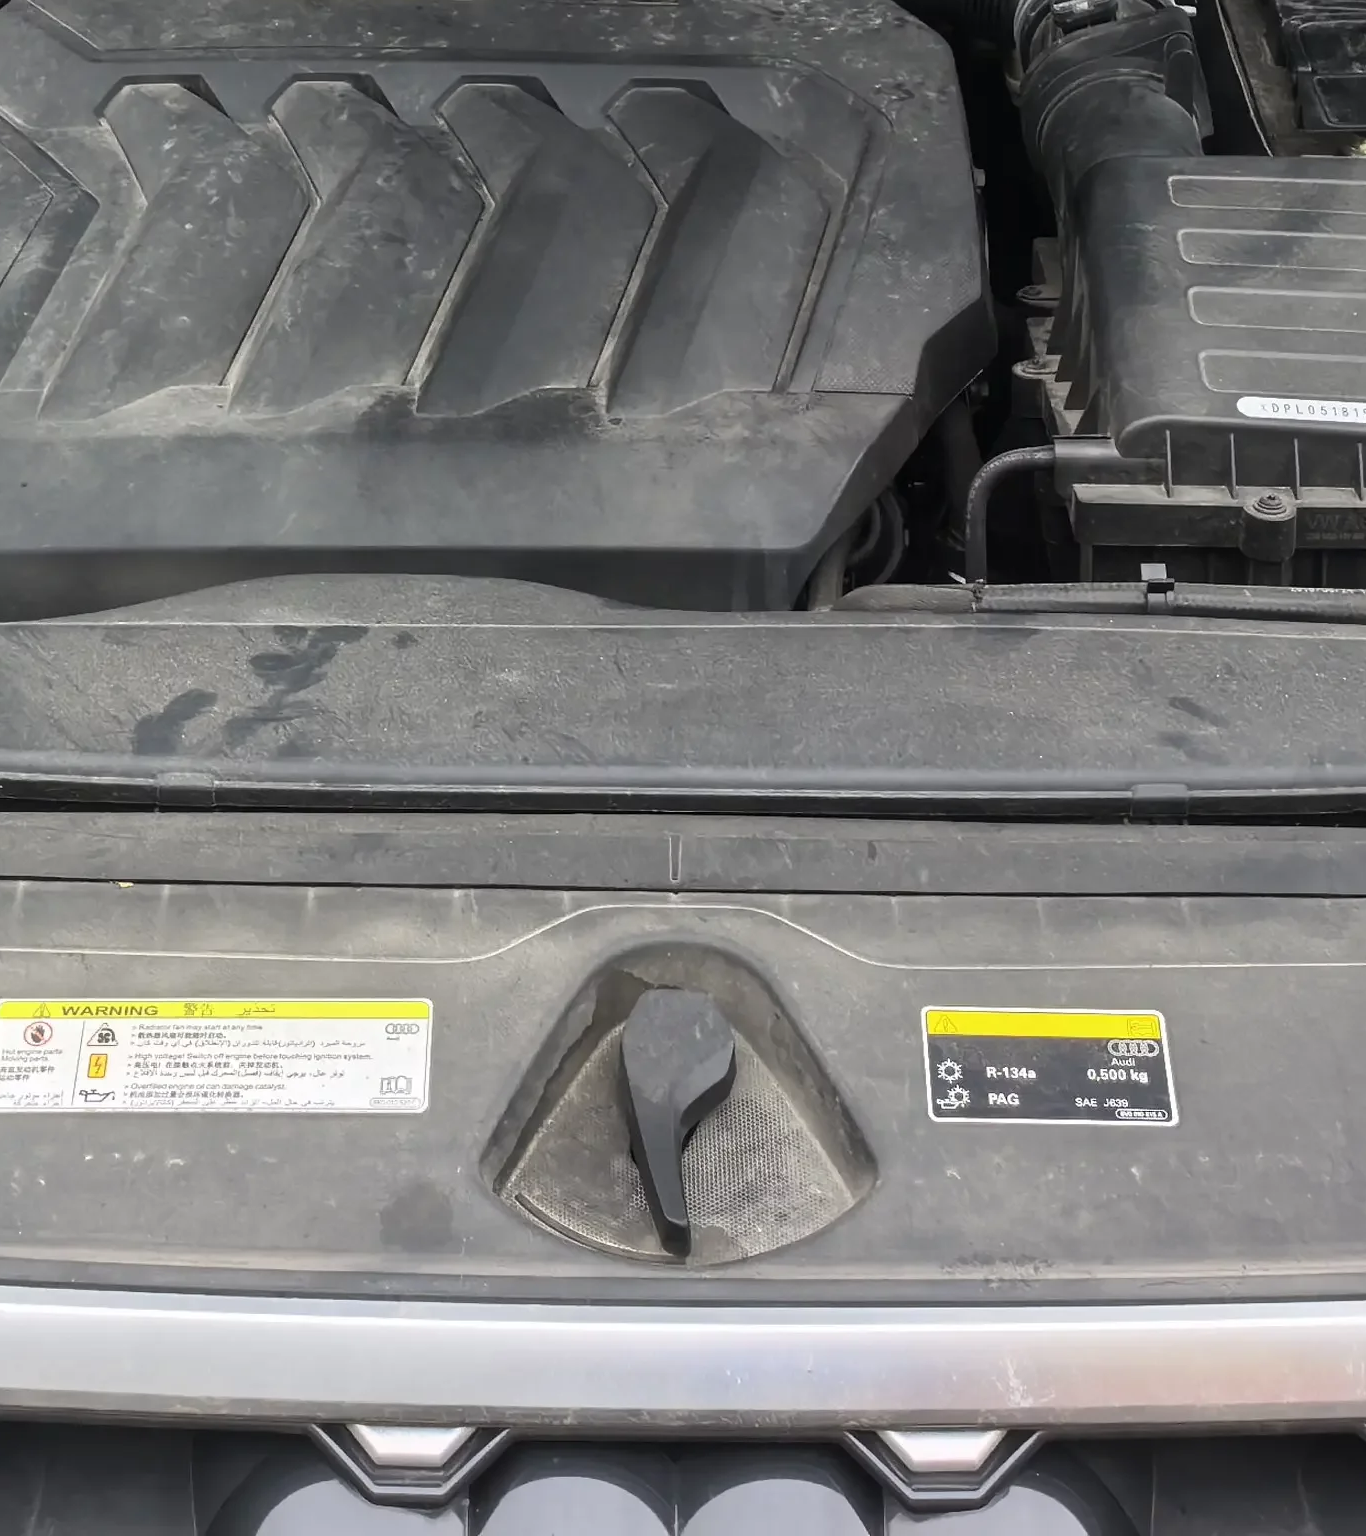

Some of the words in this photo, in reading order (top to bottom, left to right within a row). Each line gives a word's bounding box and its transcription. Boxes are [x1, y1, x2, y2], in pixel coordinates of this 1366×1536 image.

[62, 1005, 159, 1016] WARNING
[237, 1002, 275, 1016] تحذير
[134, 1053, 152, 1061] High
[187, 1053, 212, 1061] Switch
[225, 1053, 251, 1061] engine
[253, 1053, 278, 1061] before
[279, 1053, 312, 1061] touching
[314, 1053, 342, 1061] ignition
[1111, 1057, 1136, 1067] Audi
[986, 1066, 1036, 1079] R-134a
[1087, 1068, 1126, 1081] 0,500
[1130, 1069, 1148, 1083] kg
[130, 1083, 167, 1091] Overfilled
[168, 1083, 195, 1091] engine
[222, 1083, 254, 1091] damage
[988, 1093, 1020, 1105] PAG
[1075, 1098, 1097, 1107] SAE
[1103, 1098, 1128, 1108] J639
